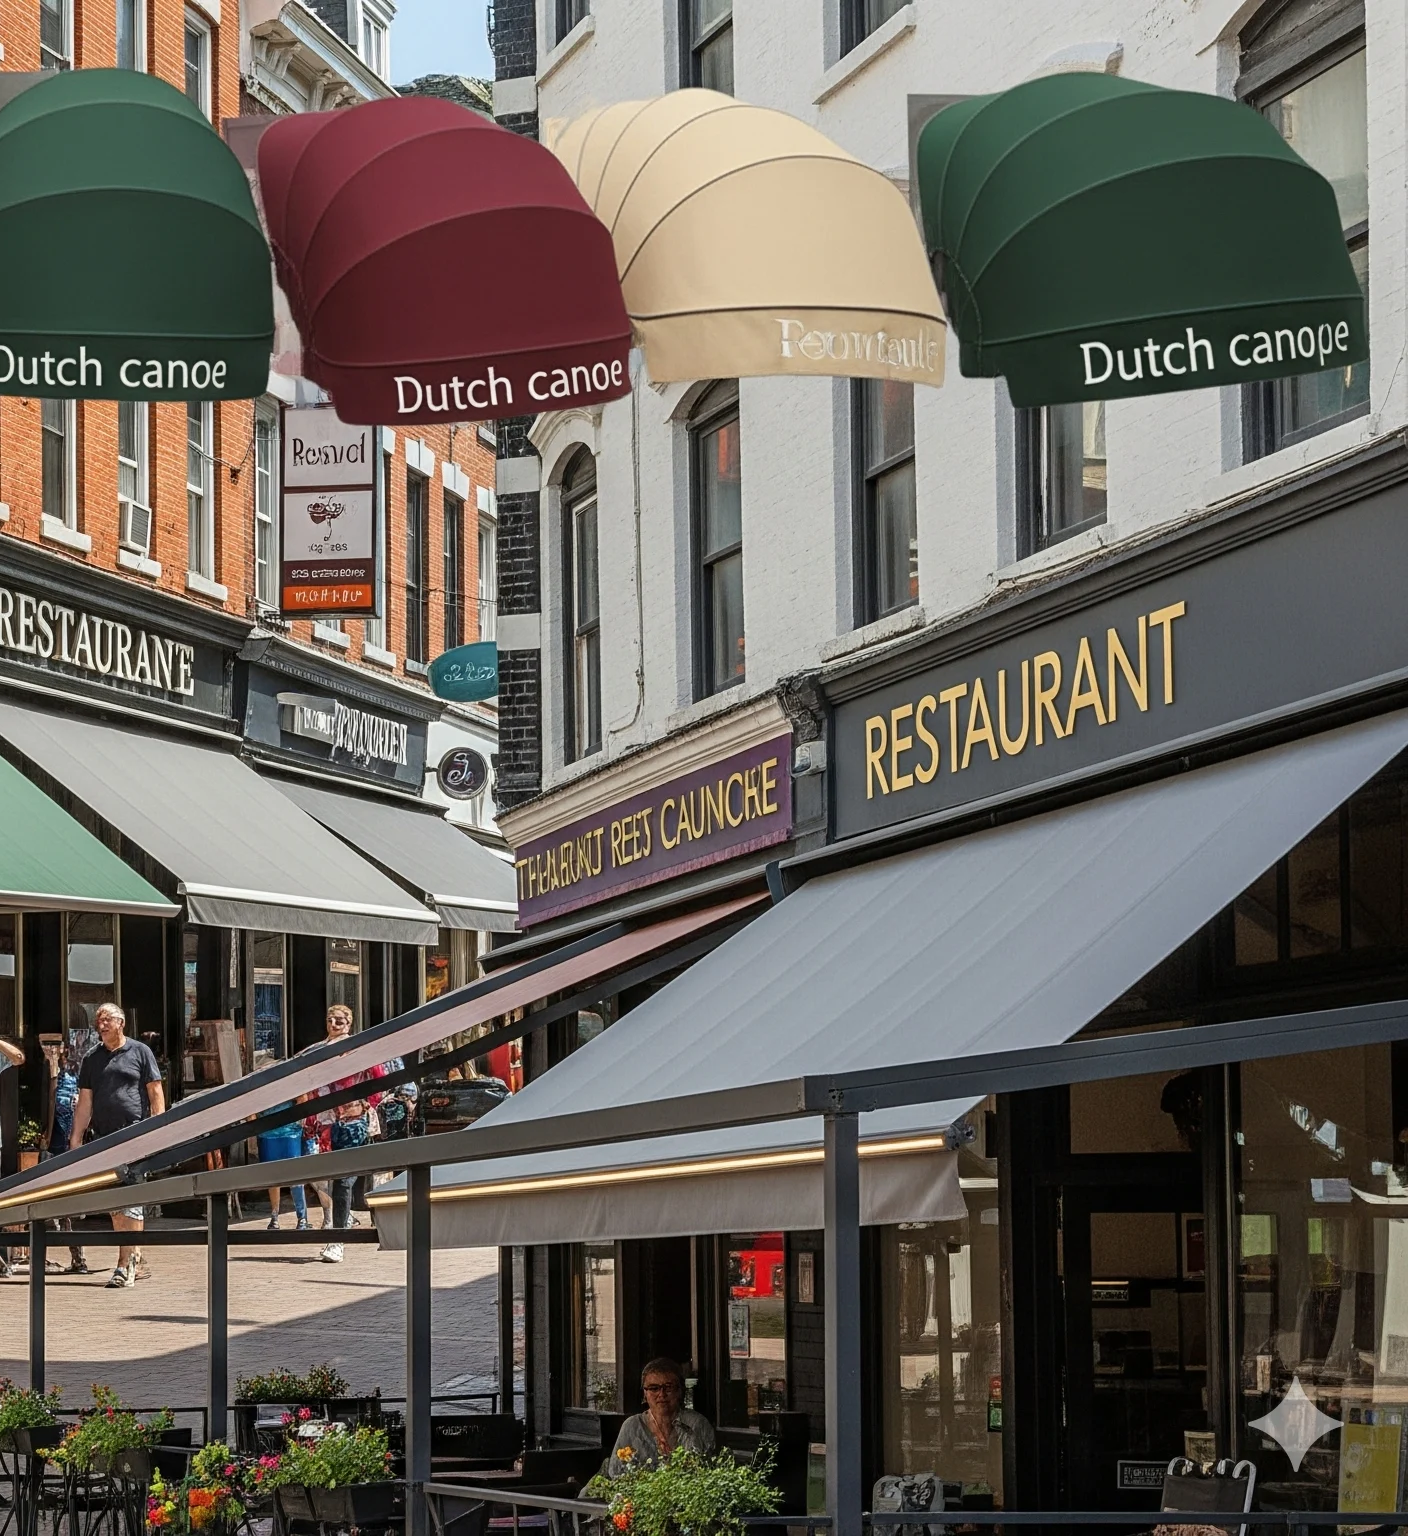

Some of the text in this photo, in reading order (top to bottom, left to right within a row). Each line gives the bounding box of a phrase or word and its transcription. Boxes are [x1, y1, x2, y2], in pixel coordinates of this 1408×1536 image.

[119, 357, 228, 390] canoe
[1080, 319, 1350, 386] Dutch canope
[393, 358, 624, 414] Dutch canoe
[864, 600, 1186, 800] RESTAURANT
